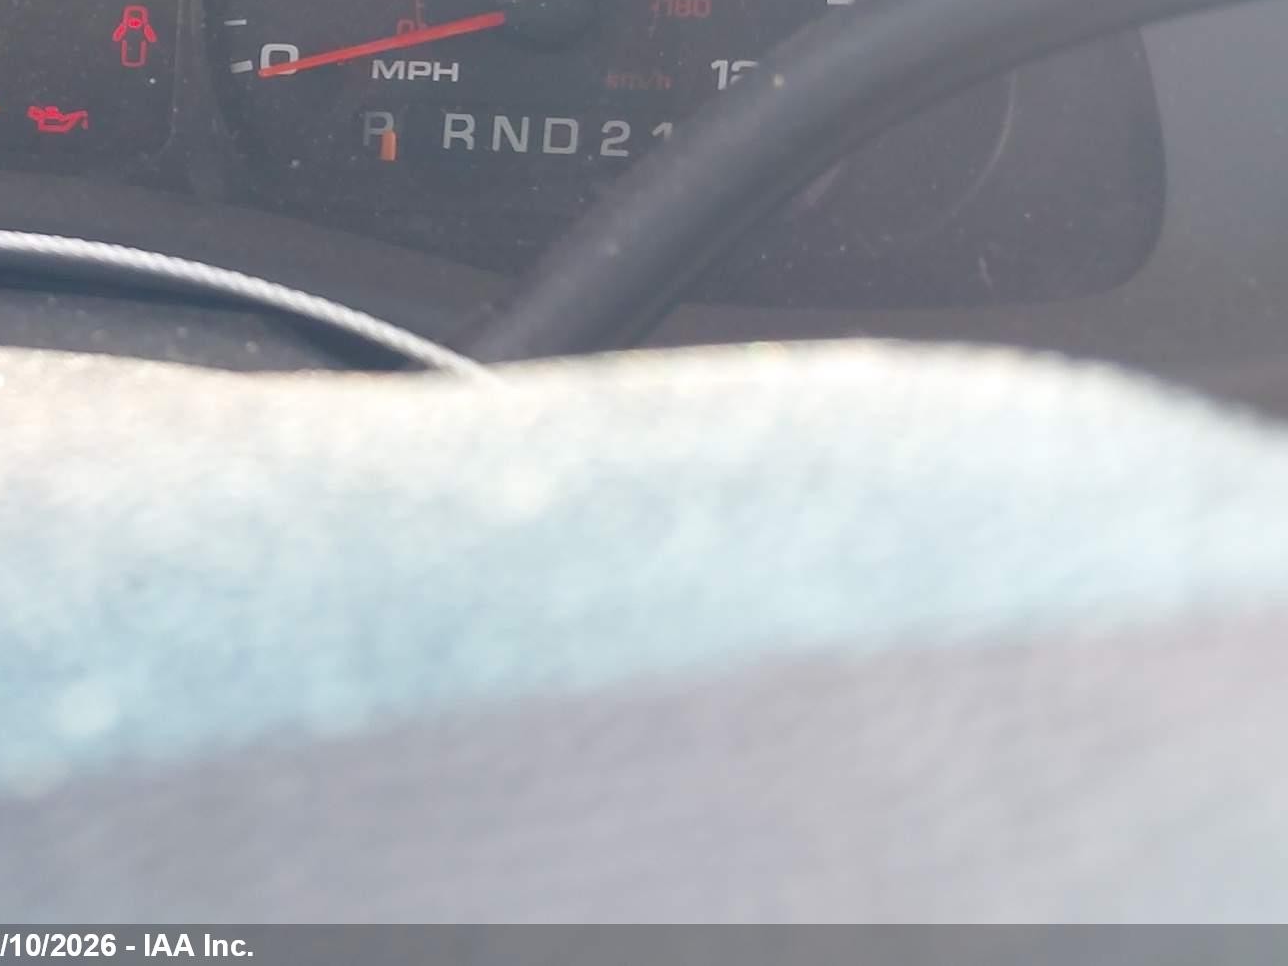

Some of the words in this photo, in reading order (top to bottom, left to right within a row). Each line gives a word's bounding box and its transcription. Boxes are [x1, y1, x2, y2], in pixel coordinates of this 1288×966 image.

[259, 44, 299, 77] 0
[371, 59, 460, 83] MPH
[363, 111, 395, 147] P
[442, 113, 476, 151] R
[492, 115, 530, 152] N
[542, 117, 580, 155] D
[599, 120, 630, 158] 2
